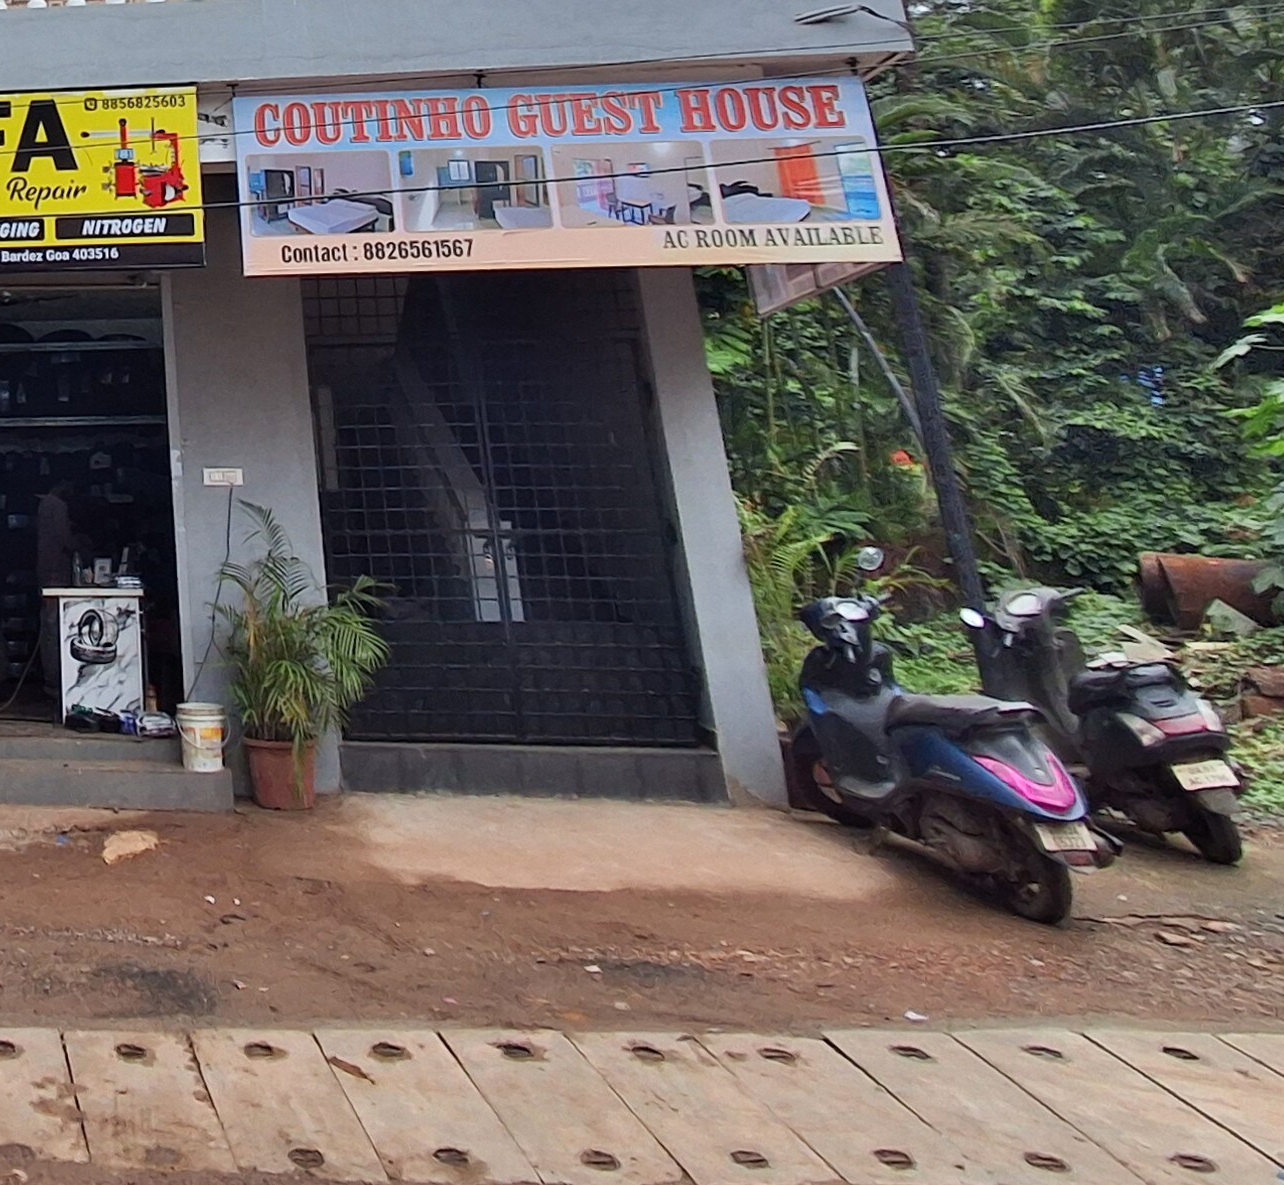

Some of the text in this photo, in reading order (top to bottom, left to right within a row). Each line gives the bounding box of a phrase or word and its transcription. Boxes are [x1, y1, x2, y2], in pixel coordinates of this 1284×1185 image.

[102, 95, 186, 110] 8856825603
[254, 85, 846, 147] COUTINHO GUEST HOUSE
[6, 176, 87, 210] Repair
[82, 217, 166, 235] NITROGEN
[663, 226, 885, 248] AC ROOM AVAILABLE
[1, 250, 43, 262] Bardez
[46, 249, 70, 261] Goa
[72, 247, 119, 260] 403516
[363, 239, 473, 260] 8826561567
